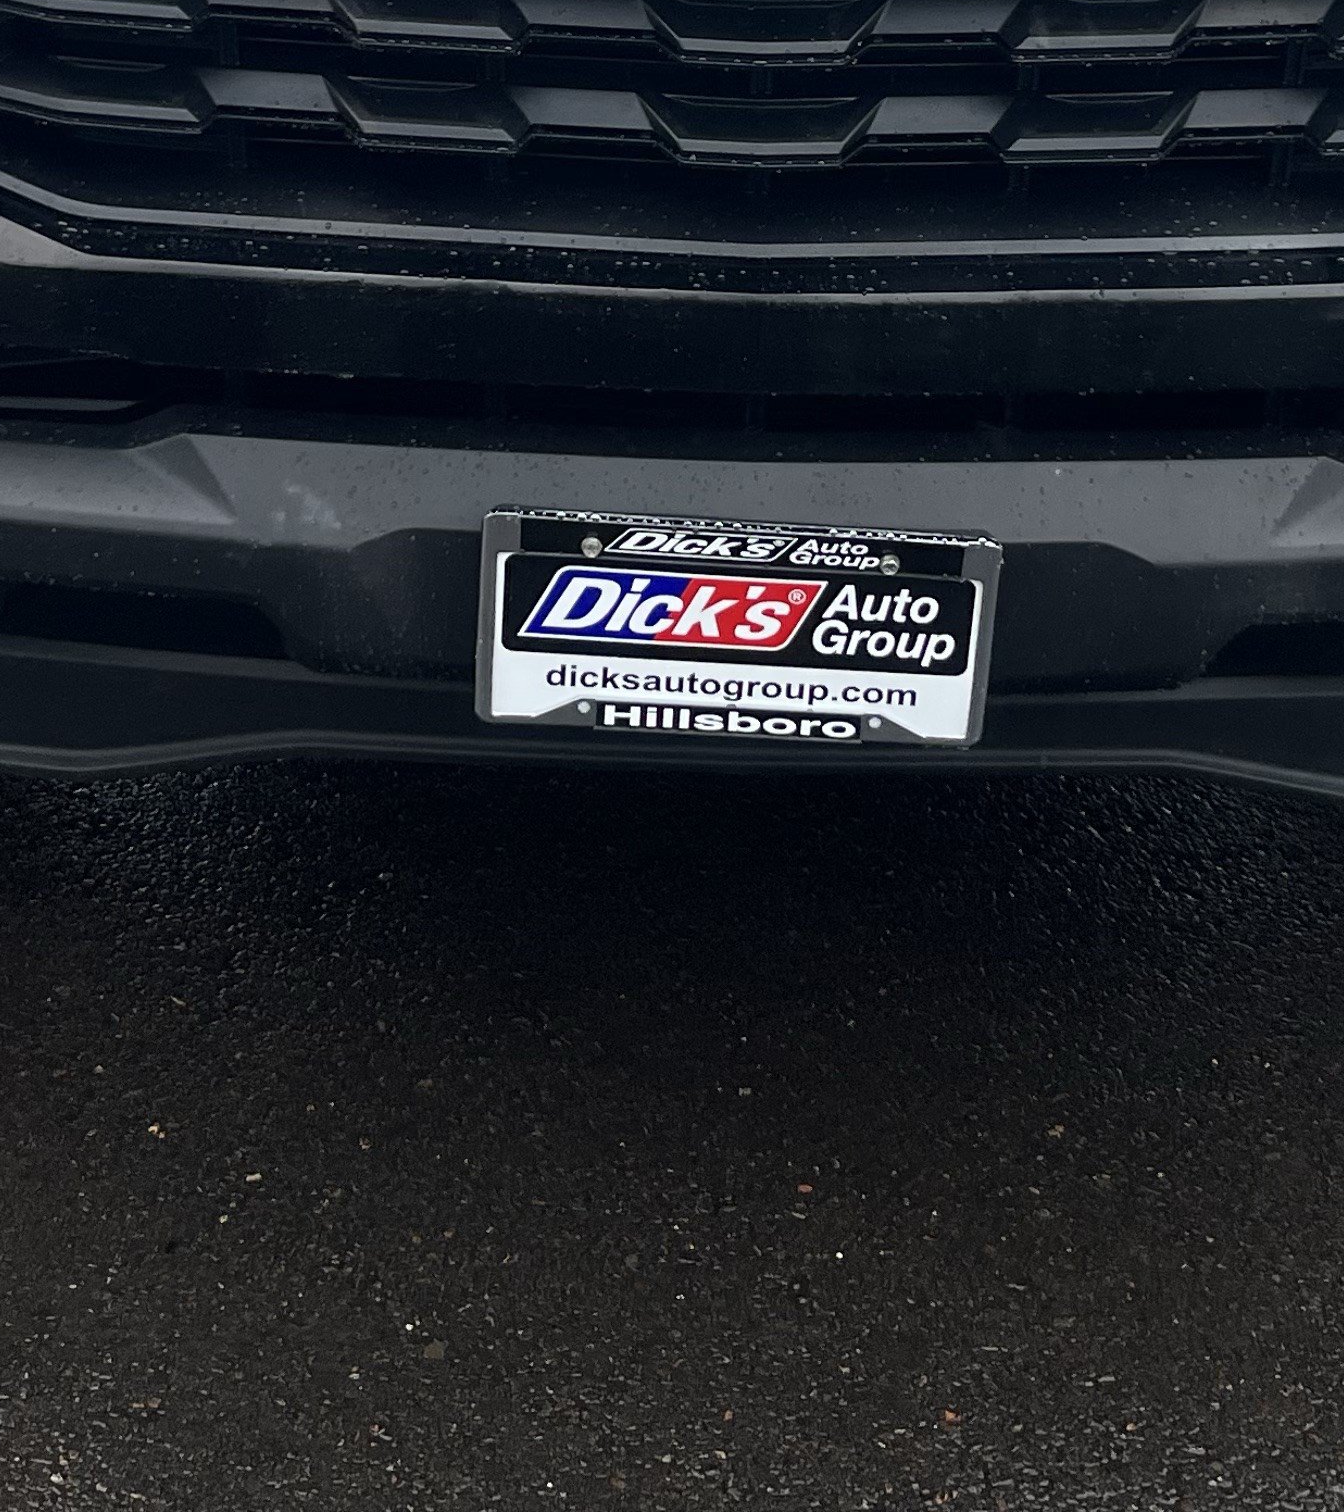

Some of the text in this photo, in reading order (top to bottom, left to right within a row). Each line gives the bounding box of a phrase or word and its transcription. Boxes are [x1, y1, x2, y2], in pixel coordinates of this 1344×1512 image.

[619, 532, 775, 559] Dick's
[788, 550, 881, 571] Group
[796, 538, 869, 555] Auto
[541, 576, 792, 641] Dick's
[823, 584, 939, 625] Auto
[812, 622, 956, 668] Group
[545, 664, 918, 706] dicksautogroup.com
[602, 704, 857, 738] Hillsboro
